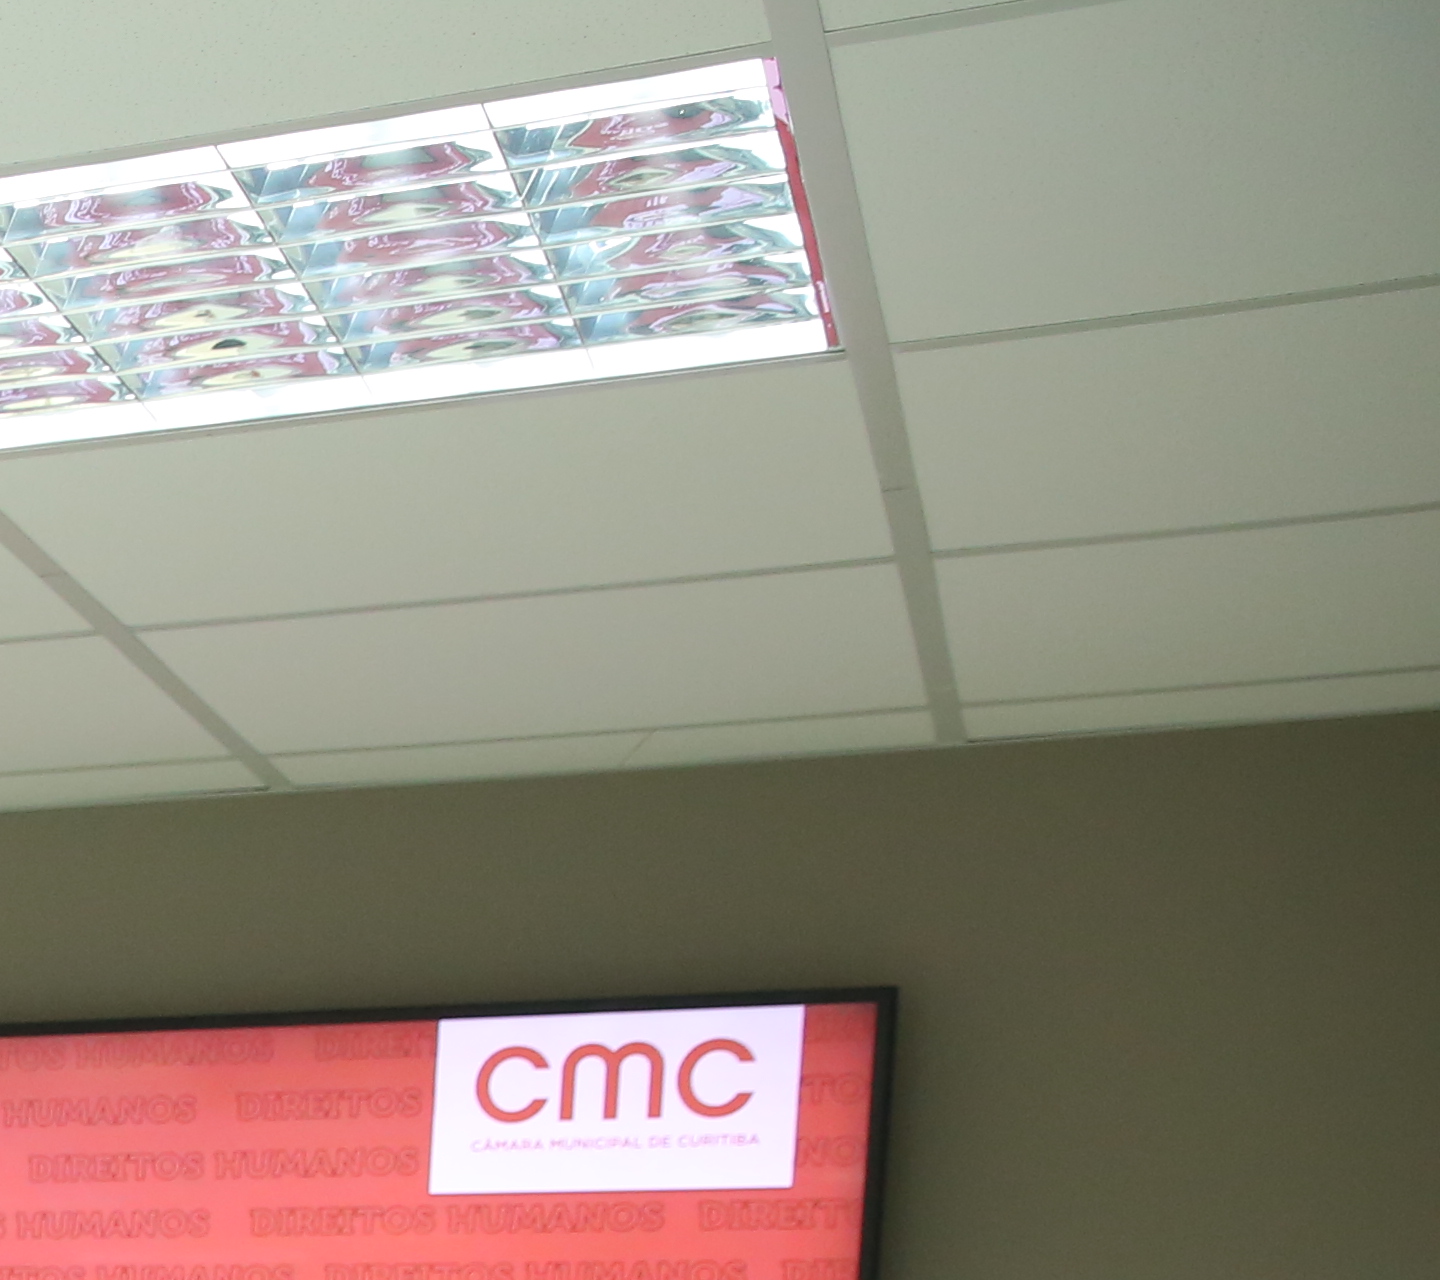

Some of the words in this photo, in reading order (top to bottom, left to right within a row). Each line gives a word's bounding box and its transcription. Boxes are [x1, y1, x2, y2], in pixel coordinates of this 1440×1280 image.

[476, 1038, 757, 1124] cmc
[3, 1095, 196, 1128] HUMANOS
[471, 1135, 545, 1154] CÂMARA
[550, 1135, 641, 1152] MUNICIPAL
[649, 1134, 672, 1150] DE
[678, 1133, 760, 1150] CURITIBA
[29, 1151, 205, 1184] DIREITOS
[214, 1147, 420, 1180] HUMANOS
[16, 1208, 210, 1240] HUMANOS
[250, 1204, 437, 1237] DIREITOS
[447, 1202, 665, 1235] HUMANOS
